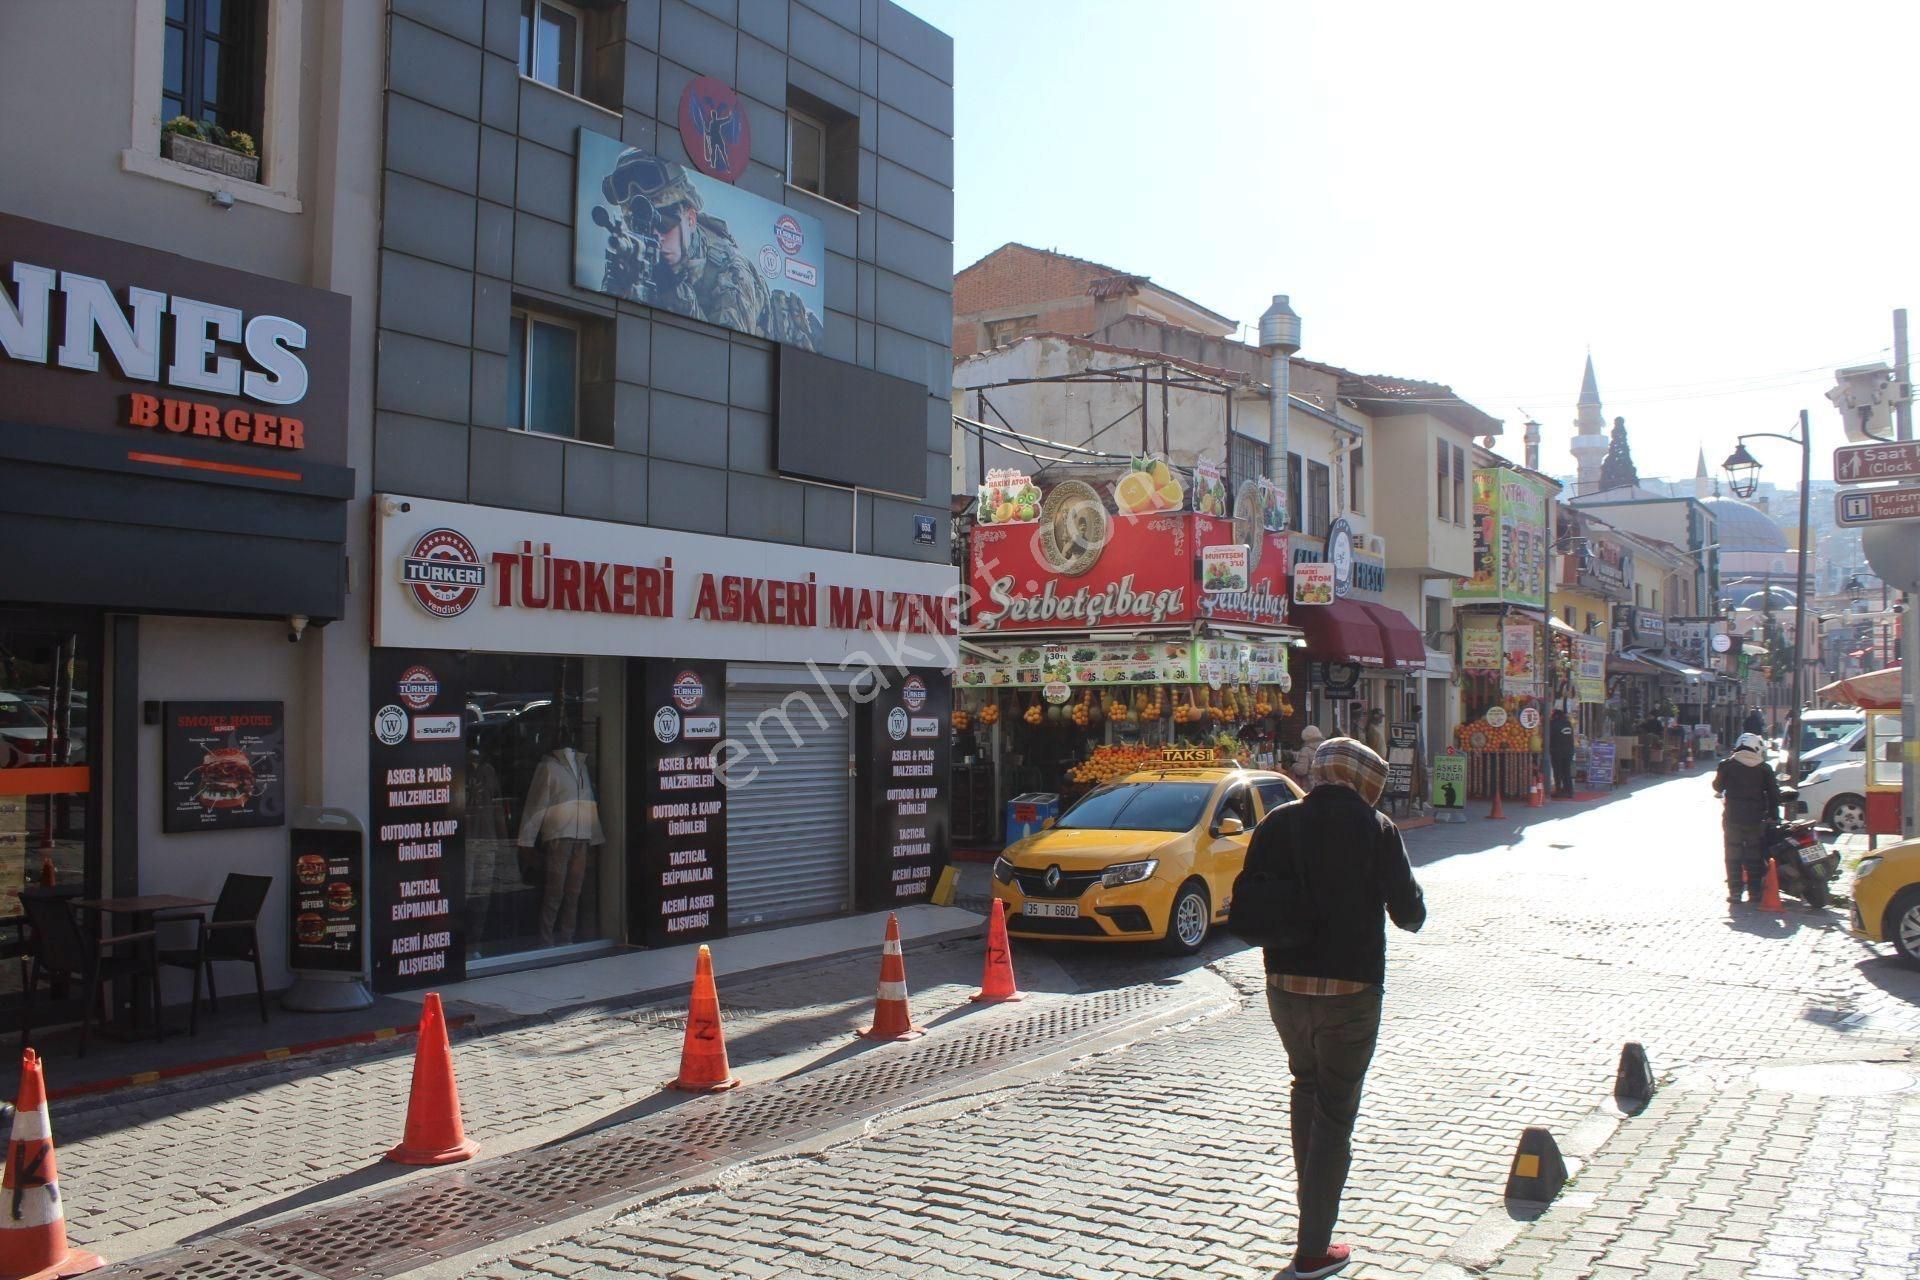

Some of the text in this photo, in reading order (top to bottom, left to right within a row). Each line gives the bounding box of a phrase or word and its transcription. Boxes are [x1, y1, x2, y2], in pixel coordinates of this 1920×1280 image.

[0, 261, 308, 405] NNES
[129, 393, 304, 449] BURGER
[1864, 448, 1907, 461] Saat
[1870, 461, 1912, 475] (Clock
[408, 562, 482, 584] TÜRKERİ
[435, 591, 456, 600] GIDA
[491, 540, 958, 636] TÜRKERİ ASKERİ MALZEME
[428, 600, 462, 614] vending
[1046, 645, 1068, 653] ATOM
[400, 682, 438, 694] TÜRKERİ
[384, 720, 398, 732] W
[891, 748, 935, 761] ASKER & POLİS
[658, 757, 685, 771] ASKER
[686, 757, 693, 770] &
[892, 763, 934, 777] MALZEMELERİ
[1437, 764, 1463, 772] ASKER
[387, 766, 452, 785] ASKER & POLİS
[660, 773, 715, 790] MALZEMELERİ
[389, 788, 450, 807] MALZEMELERİ
[887, 787, 938, 801] OUTDOOR & KAMP
[653, 801, 722, 819] OUTDOOR & KAMP
[898, 800, 927, 816] ÜRÜNLERİ
[381, 820, 458, 841] OUTDOOR & KAMP
[668, 818, 707, 836] ÜRÜNLERİ
[899, 827, 926, 840] TACTICAL
[398, 839, 442, 862] ÜRÜNLERİ
[669, 849, 707, 866] TACTICAL
[893, 842, 931, 857] EKİPMANLAR
[662, 867, 713, 886] EKİPMANLAR
[892, 866, 931, 882] ACEMİ ASKER
[400, 879, 440, 898] TACTICAL
[896, 880, 927, 897] ALIŞVERİŞİ
[392, 898, 449, 921] EKİPMANLAR
[661, 894, 715, 915] ACEMİ ASKER
[1028, 904, 1076, 916] 35 T 6802
[667, 910, 709, 932] ALIŞVERİŞİ
[392, 932, 451, 955] ACEMİ ASKER
[398, 954, 445, 976] ALIŞVERİŞİ
